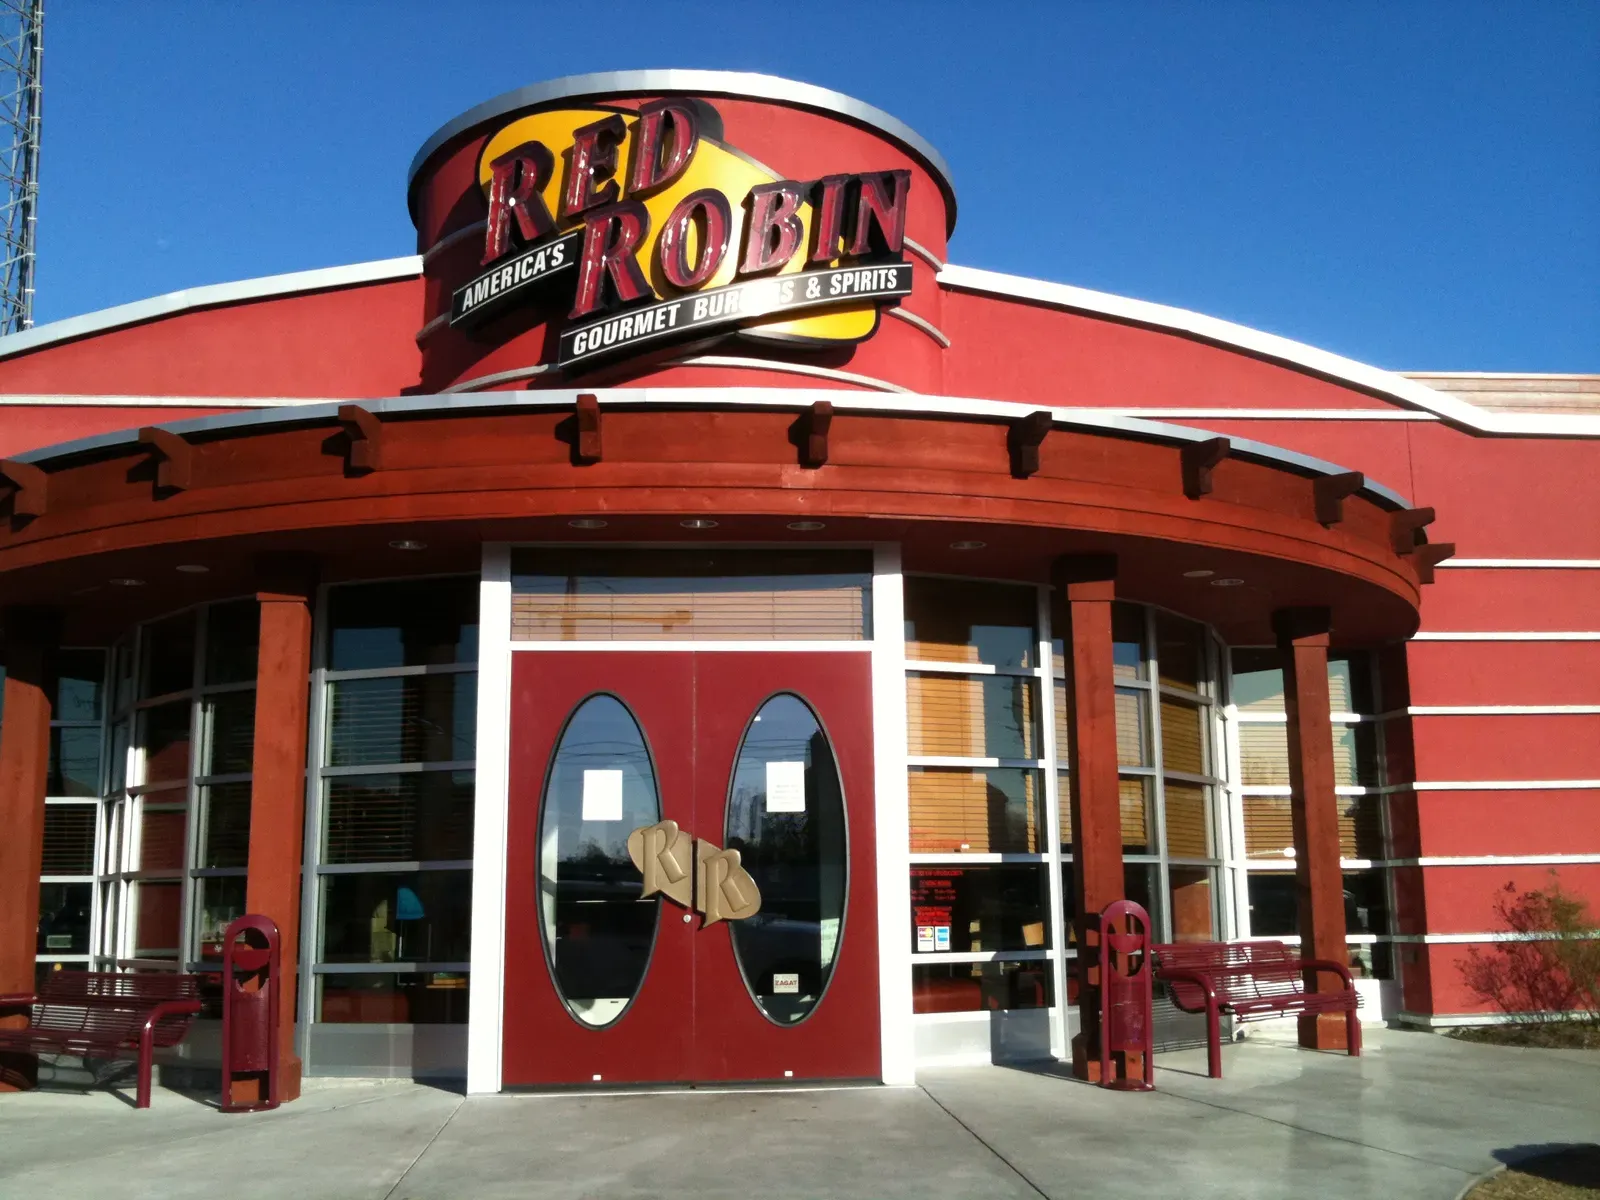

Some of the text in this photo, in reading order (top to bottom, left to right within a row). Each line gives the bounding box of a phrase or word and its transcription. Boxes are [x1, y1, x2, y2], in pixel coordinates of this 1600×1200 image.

[480, 97, 701, 267] RED
[462, 242, 565, 312] AMERICA'S
[567, 168, 911, 320] ROBIN
[573, 269, 898, 355] GOURMET BURS & SPIRITS
